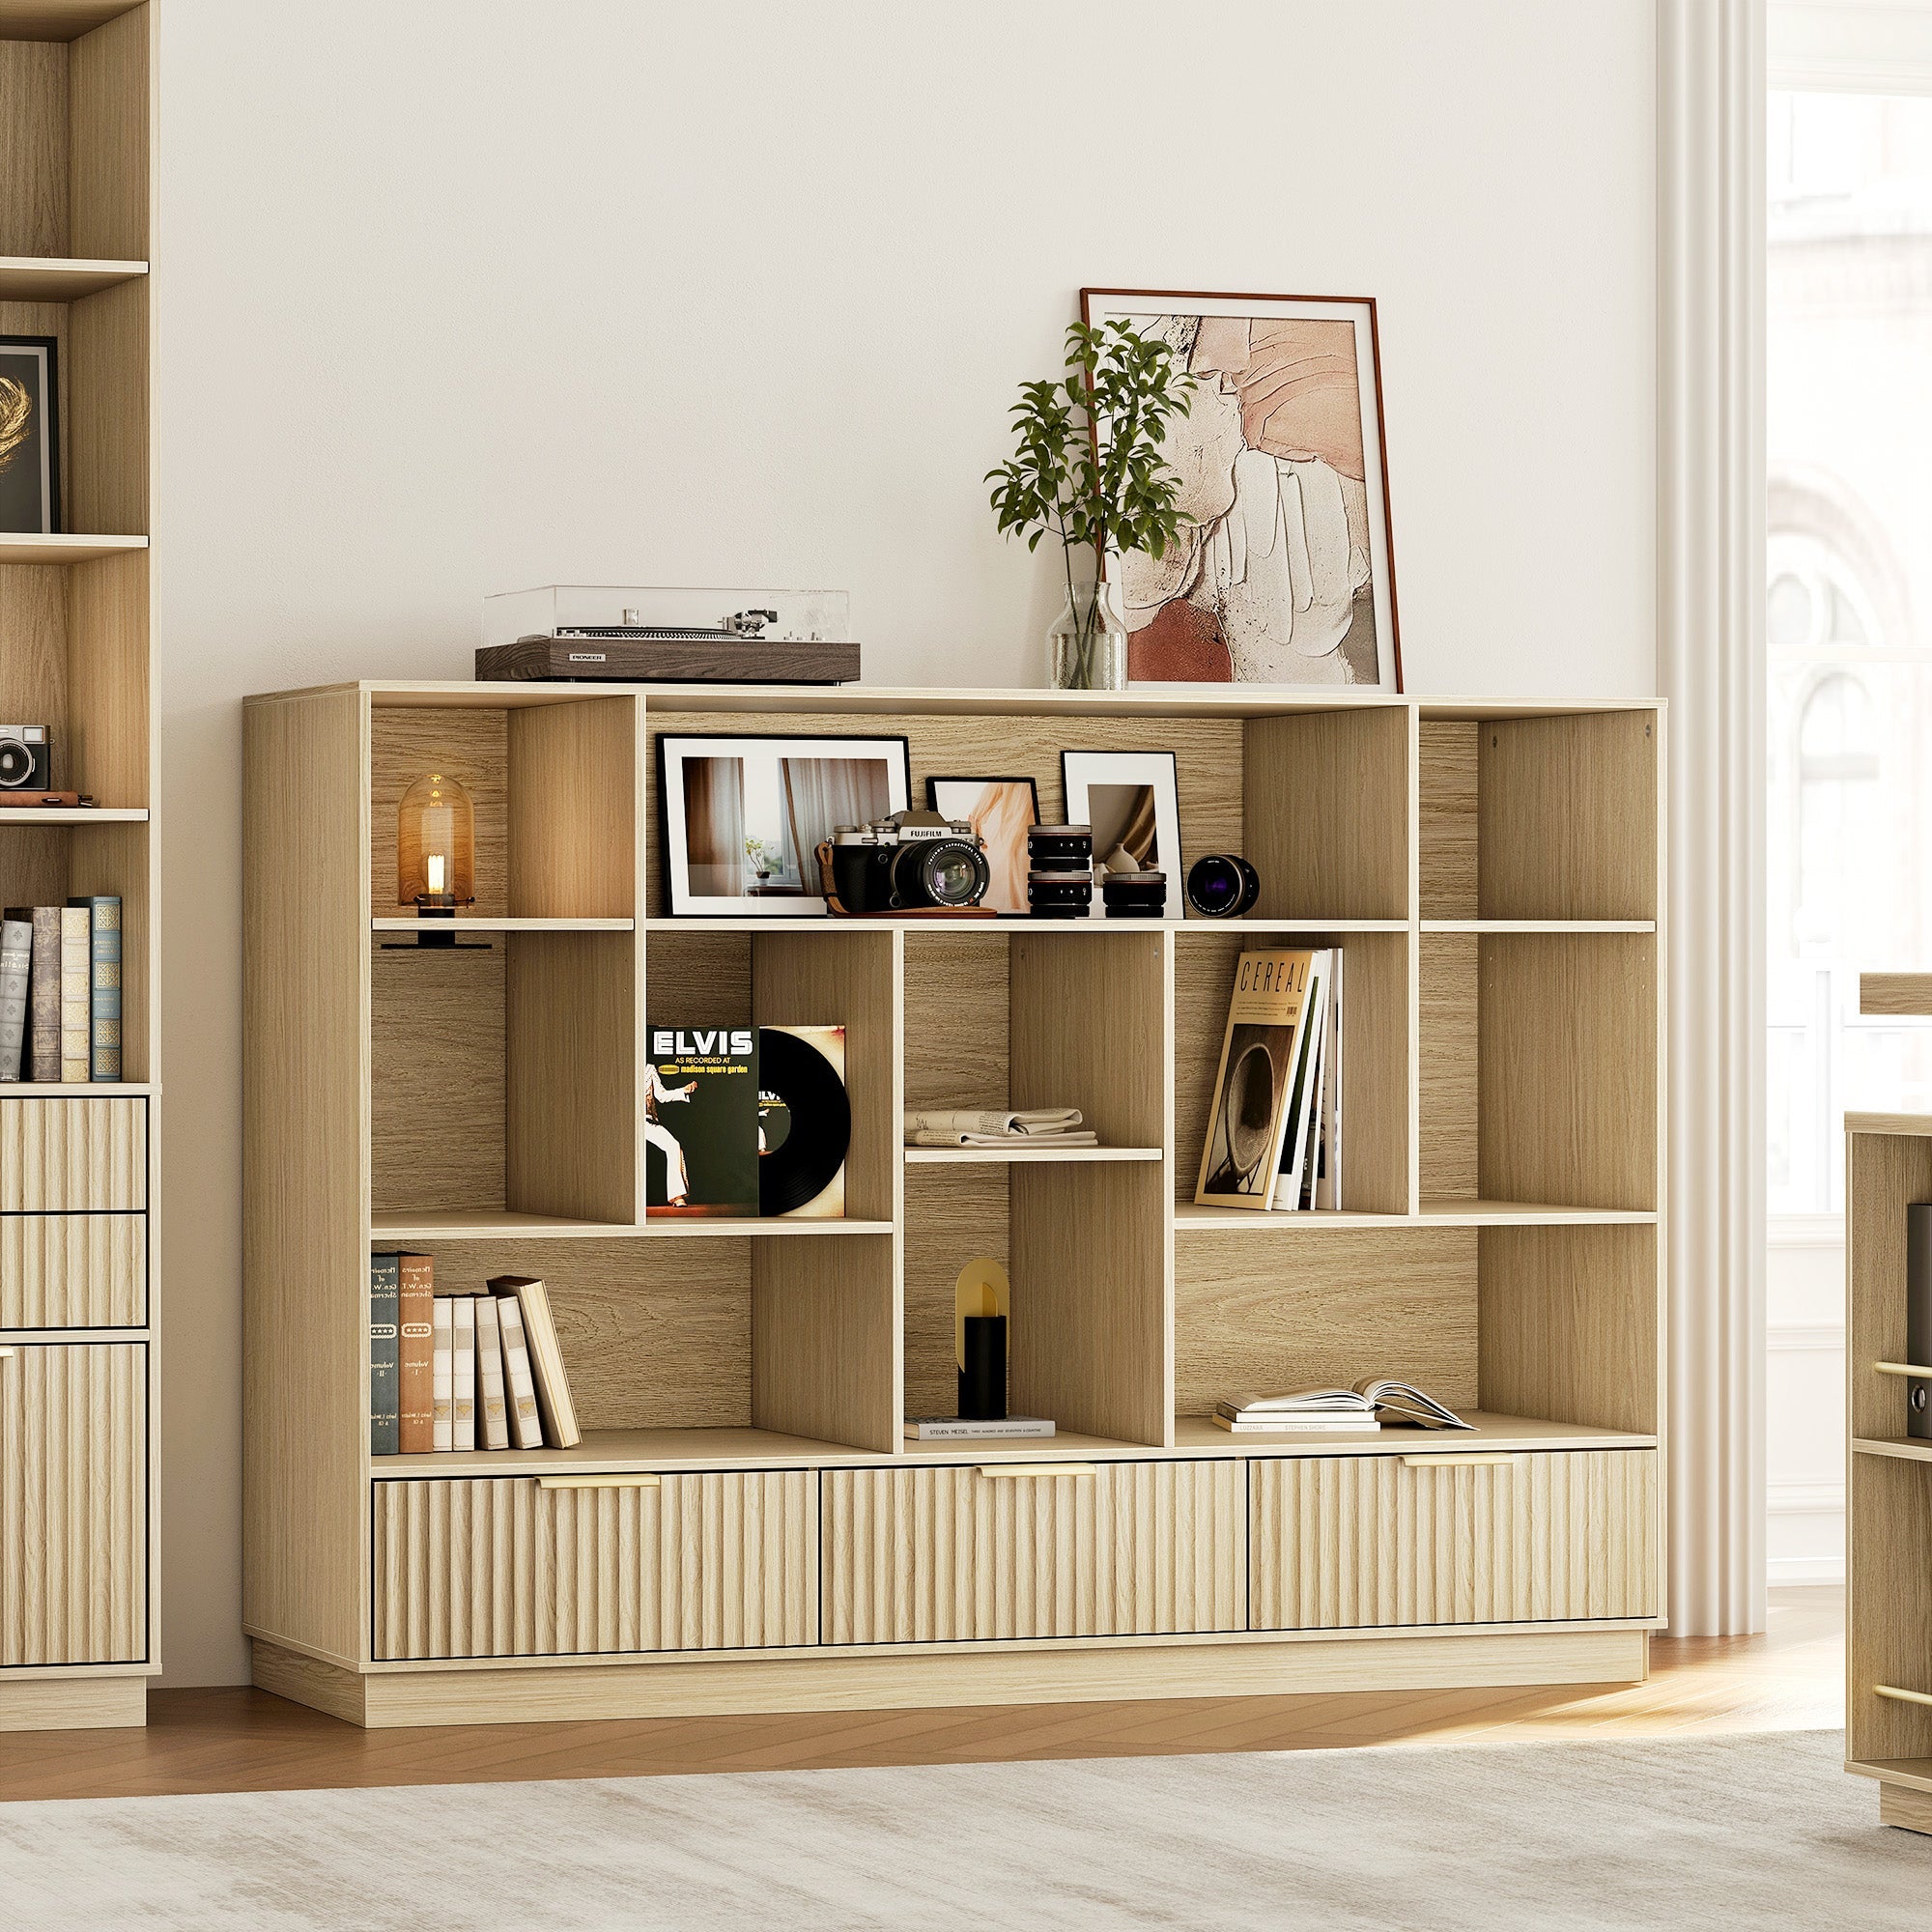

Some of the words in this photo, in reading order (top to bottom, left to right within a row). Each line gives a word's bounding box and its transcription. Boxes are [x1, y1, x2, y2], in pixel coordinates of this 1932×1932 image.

[1240, 961, 1305, 992] CEREAL
[653, 1031, 753, 1055] ELVIS
[681, 1065, 705, 1073] madison
[706, 1065, 726, 1075] square
[727, 1065, 749, 1074] garden
